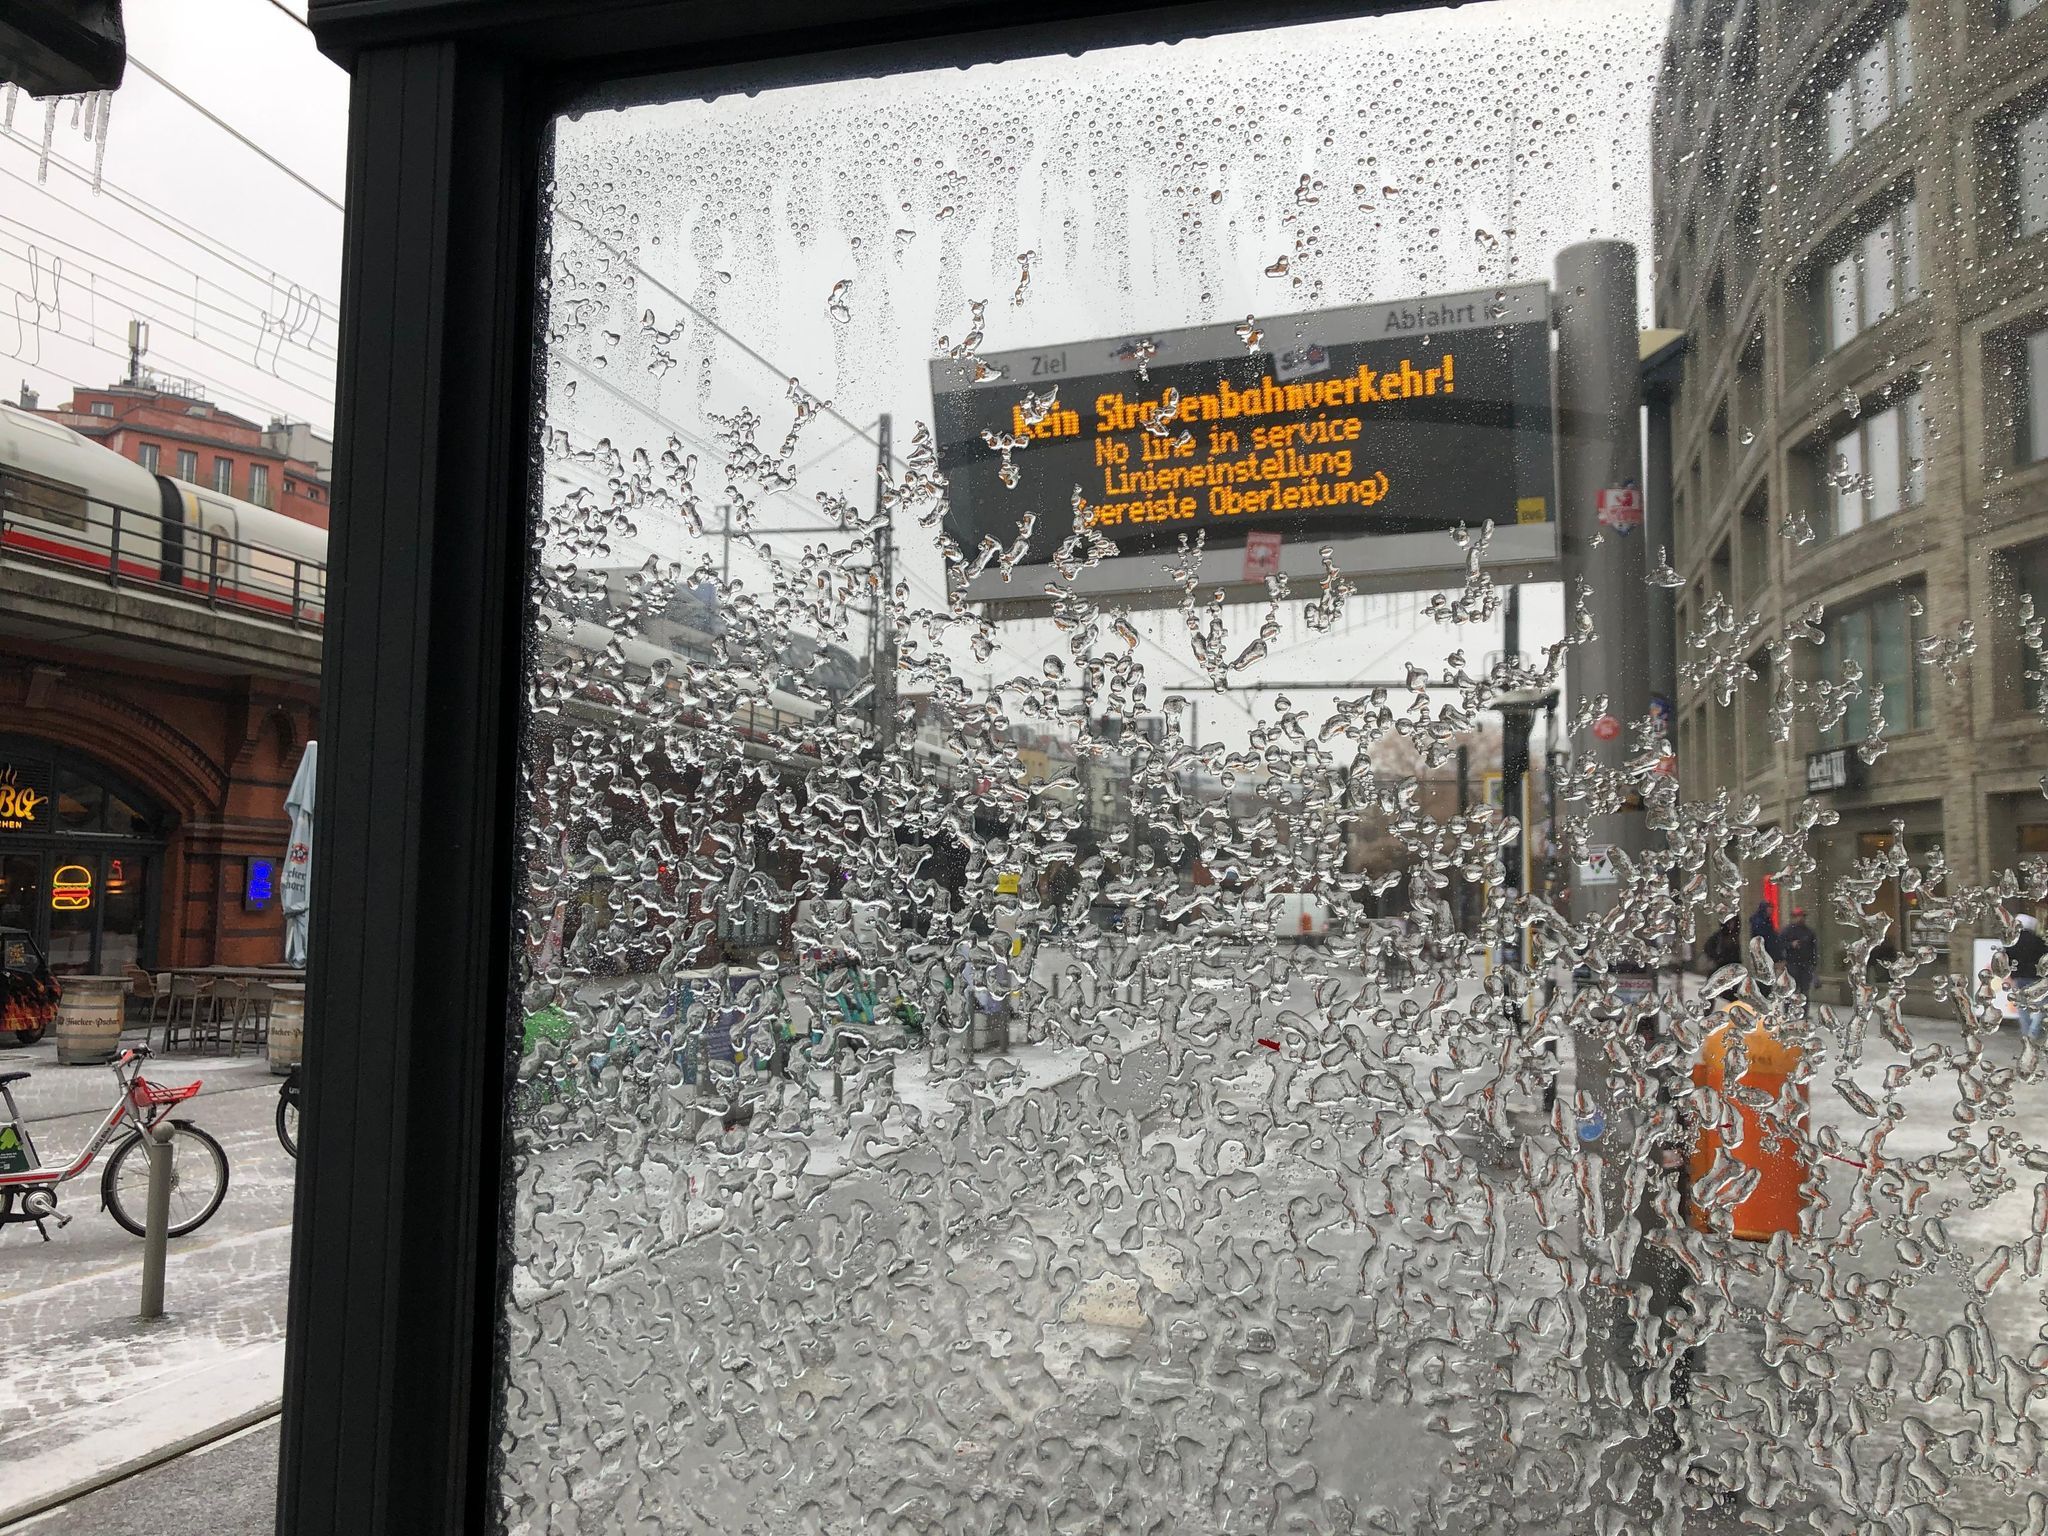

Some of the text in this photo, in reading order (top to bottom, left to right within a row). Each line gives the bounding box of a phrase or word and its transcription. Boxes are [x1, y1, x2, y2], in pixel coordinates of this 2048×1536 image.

[1385, 302, 1474, 332] Abfahrt
[1032, 352, 1068, 375] Ziel
[1096, 413, 1363, 466] No line in service
[1104, 448, 1354, 496] Linieneinstellung
[1209, 471, 1391, 516] Oberleitung)
[0, 820, 22, 829] HEN
